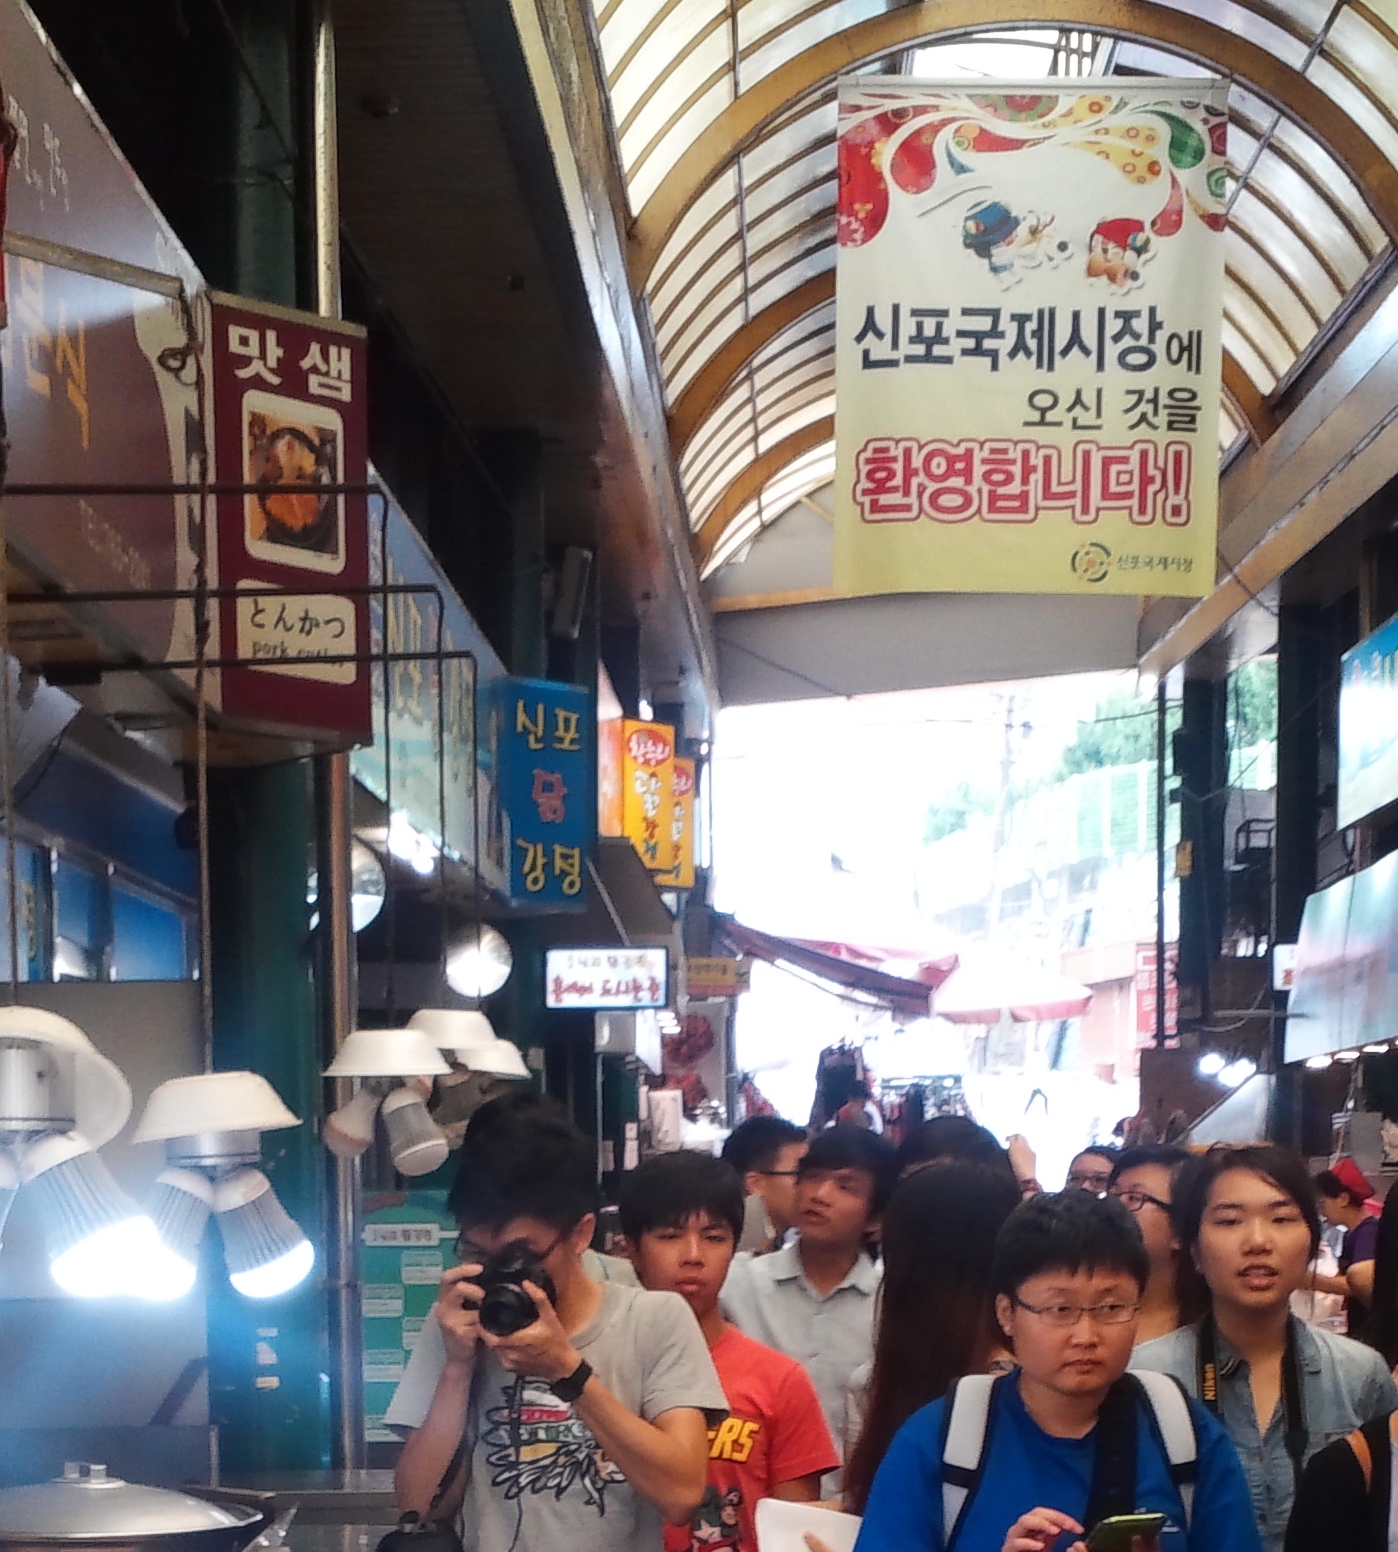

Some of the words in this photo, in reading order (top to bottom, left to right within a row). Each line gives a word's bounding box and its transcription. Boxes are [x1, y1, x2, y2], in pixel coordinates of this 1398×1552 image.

[853, 302, 1203, 375] 신포국제시장에
[1022, 386, 1103, 432] 오신
[1121, 387, 1203, 433] 것을
[855, 440, 1191, 524] 환영합니다!
[249, 598, 346, 639] とんかつ
[515, 697, 582, 751] 신포
[515, 837, 582, 897] 강정
